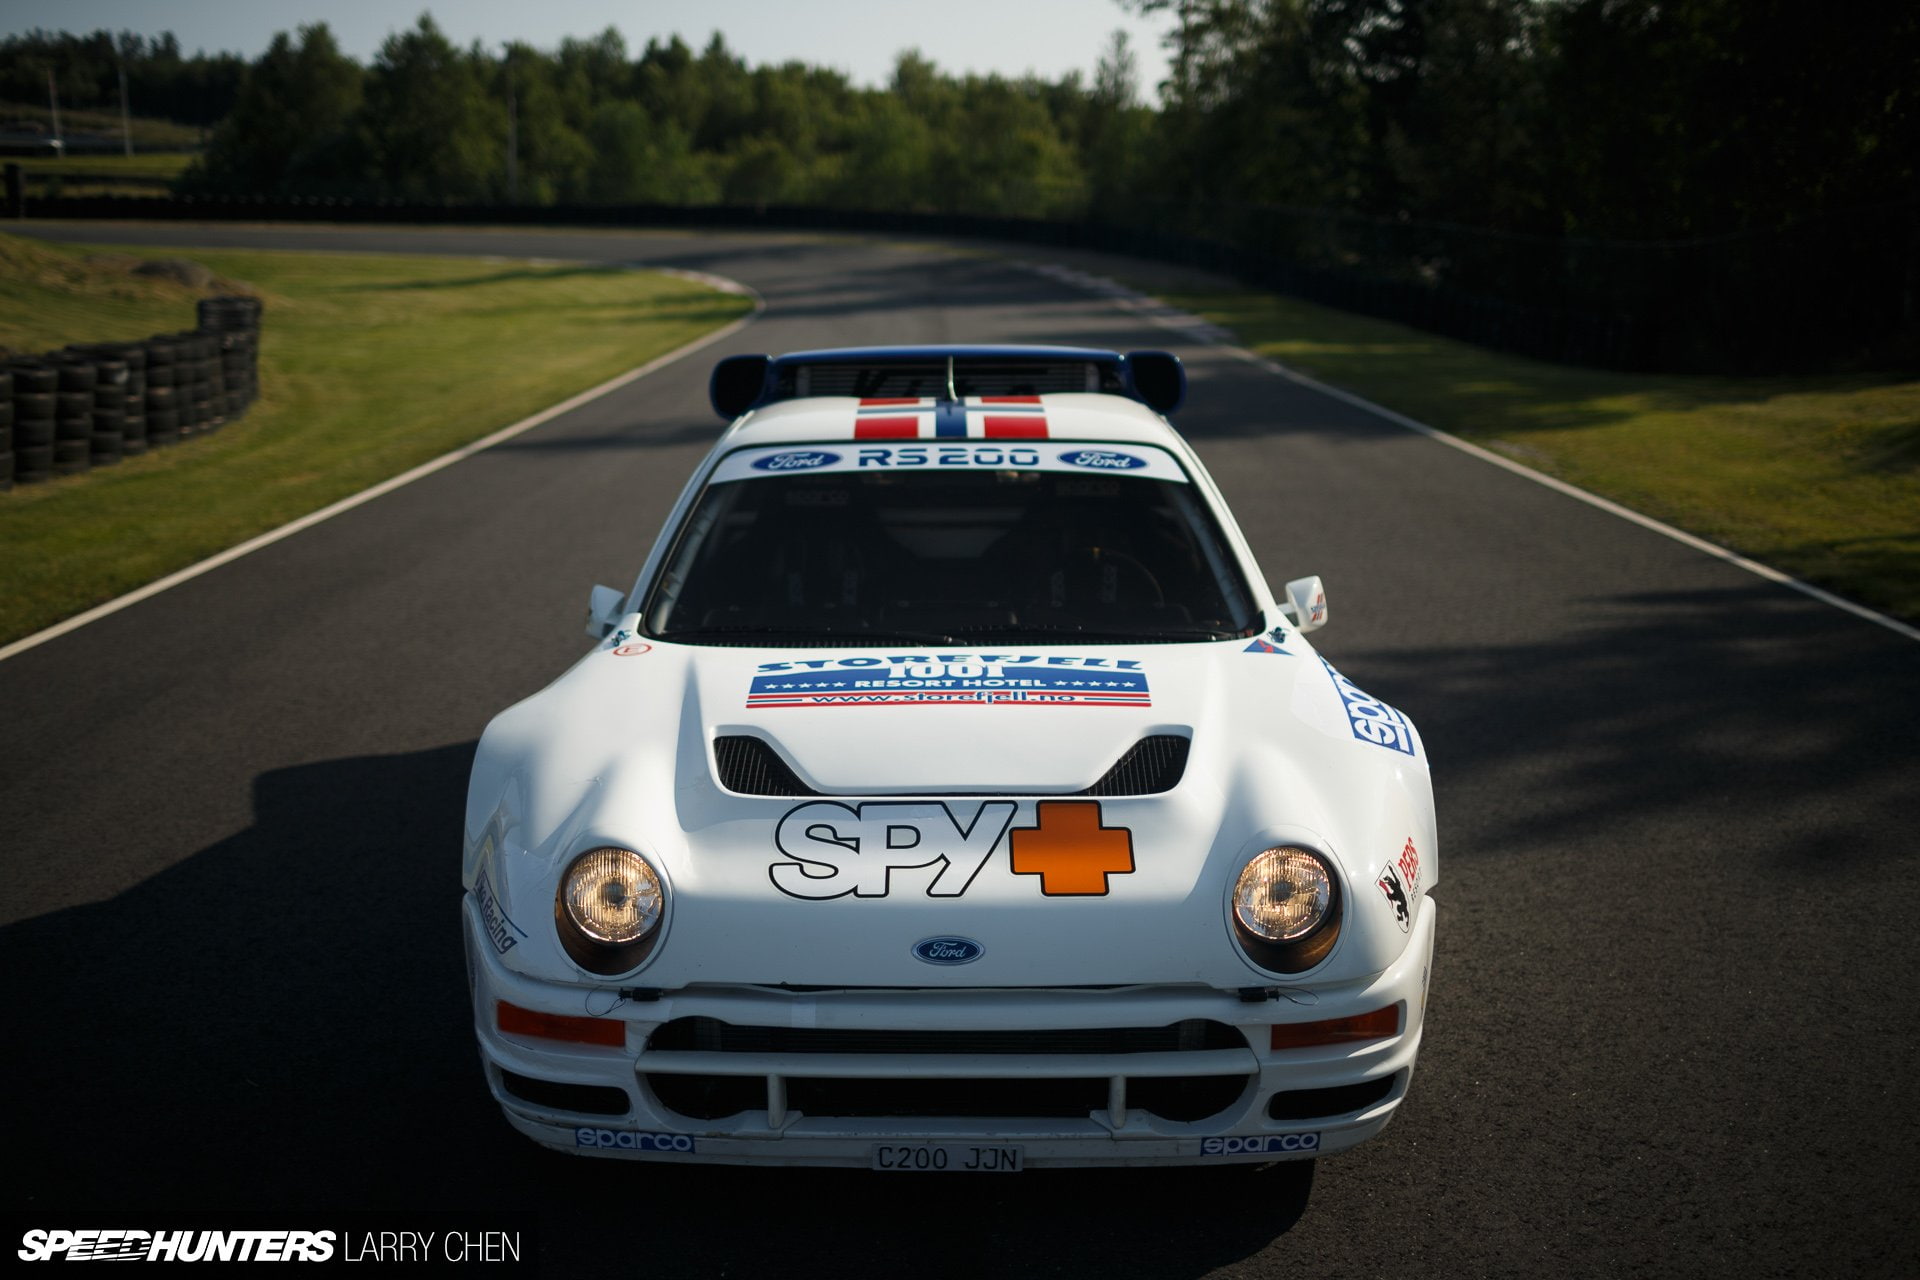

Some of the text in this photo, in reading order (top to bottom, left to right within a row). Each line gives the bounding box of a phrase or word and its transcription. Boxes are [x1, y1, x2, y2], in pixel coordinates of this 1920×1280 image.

[767, 452, 825, 469] Ford
[1074, 451, 1131, 468] Ford
[757, 654, 1144, 673] STOREFJELL
[888, 663, 1005, 679] 1001
[854, 678, 1047, 689] RESORT HOTEL
[811, 690, 1077, 704] www.storefjell.no
[1398, 836, 1419, 892] PERS
[483, 896, 518, 954] Racing
[577, 1127, 692, 1151] sparco
[1203, 1133, 1319, 1156] sparco
[878, 1146, 1017, 1170] C200 JJN
